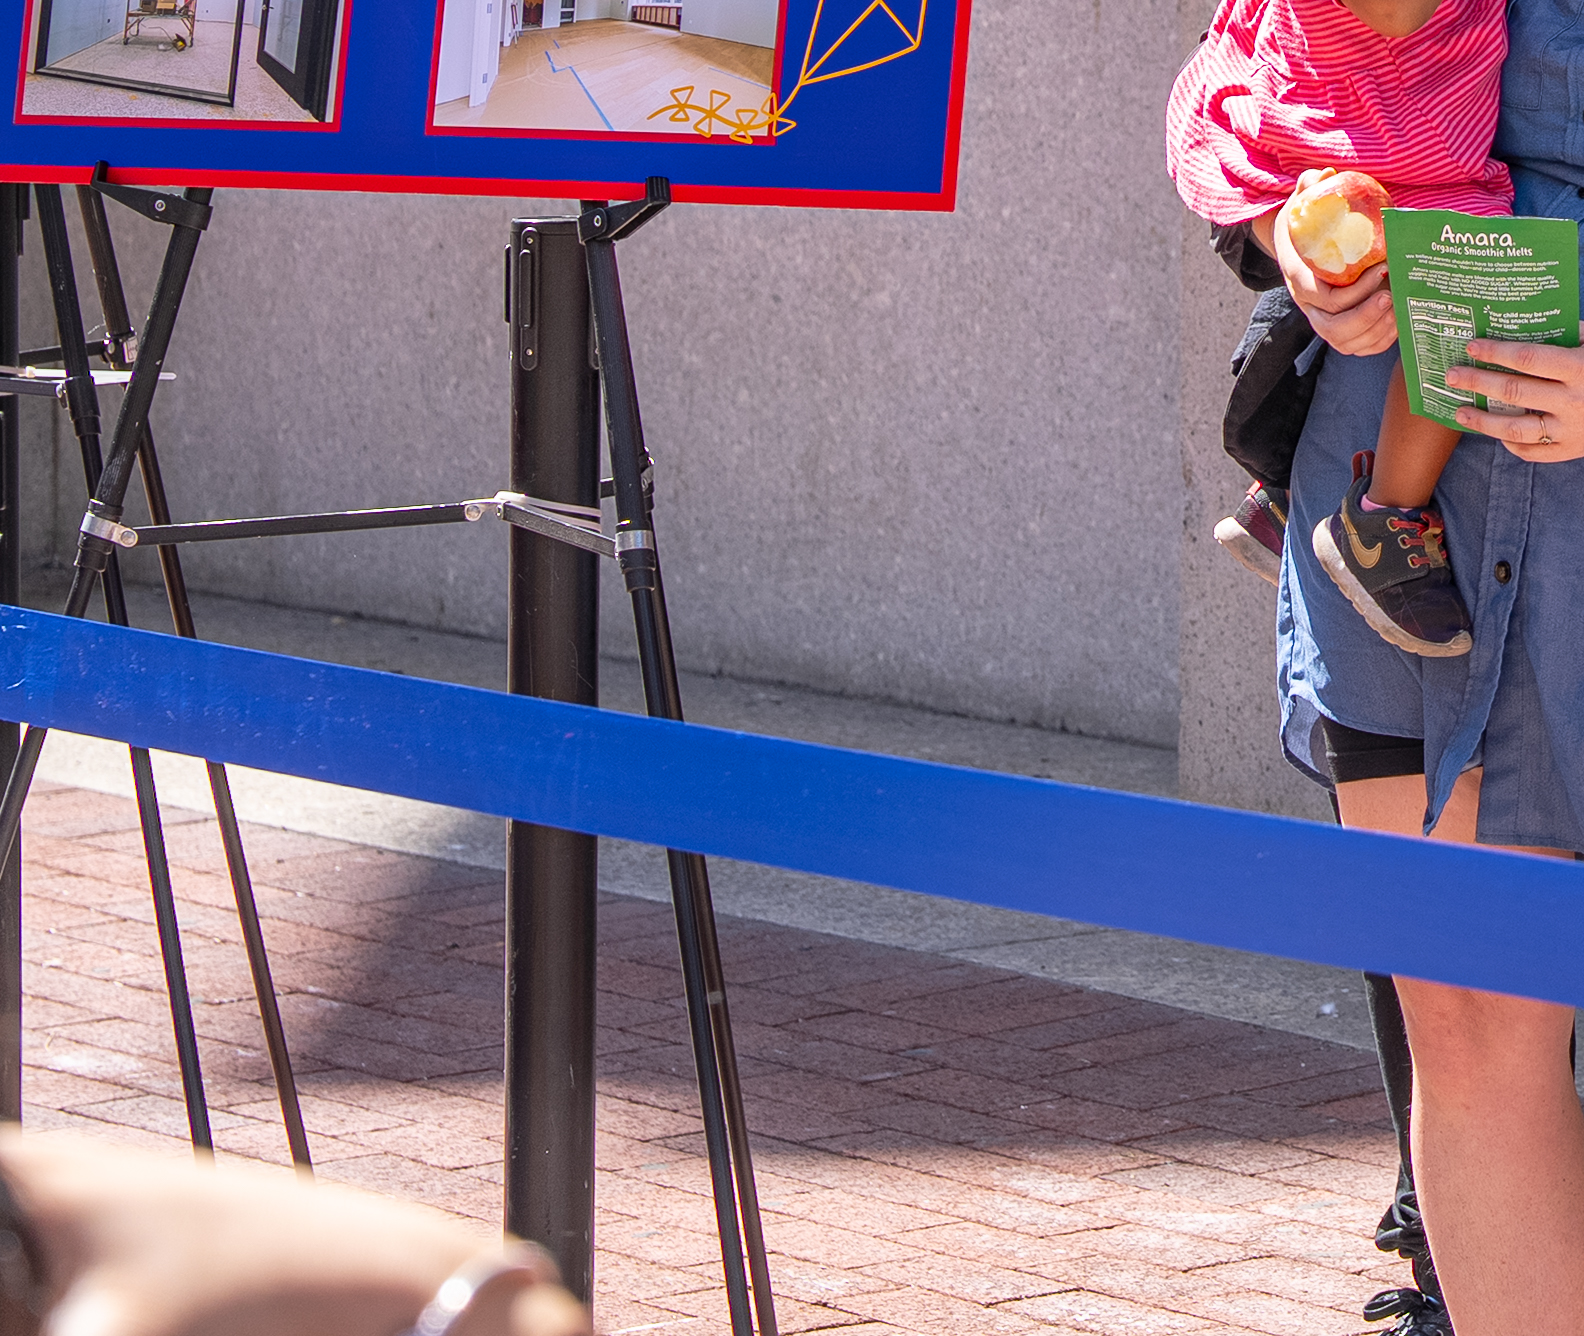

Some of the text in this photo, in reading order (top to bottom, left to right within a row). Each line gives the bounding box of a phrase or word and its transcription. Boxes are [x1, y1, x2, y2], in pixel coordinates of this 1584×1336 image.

[1440, 224, 1513, 246] Amara
[1431, 242, 1533, 257] Organic Smoothie Melts
[1410, 300, 1446, 310] Nutrition
[1448, 305, 1470, 314] Facts
[1414, 323, 1438, 332] Calories
[1458, 329, 1473, 338] 140
